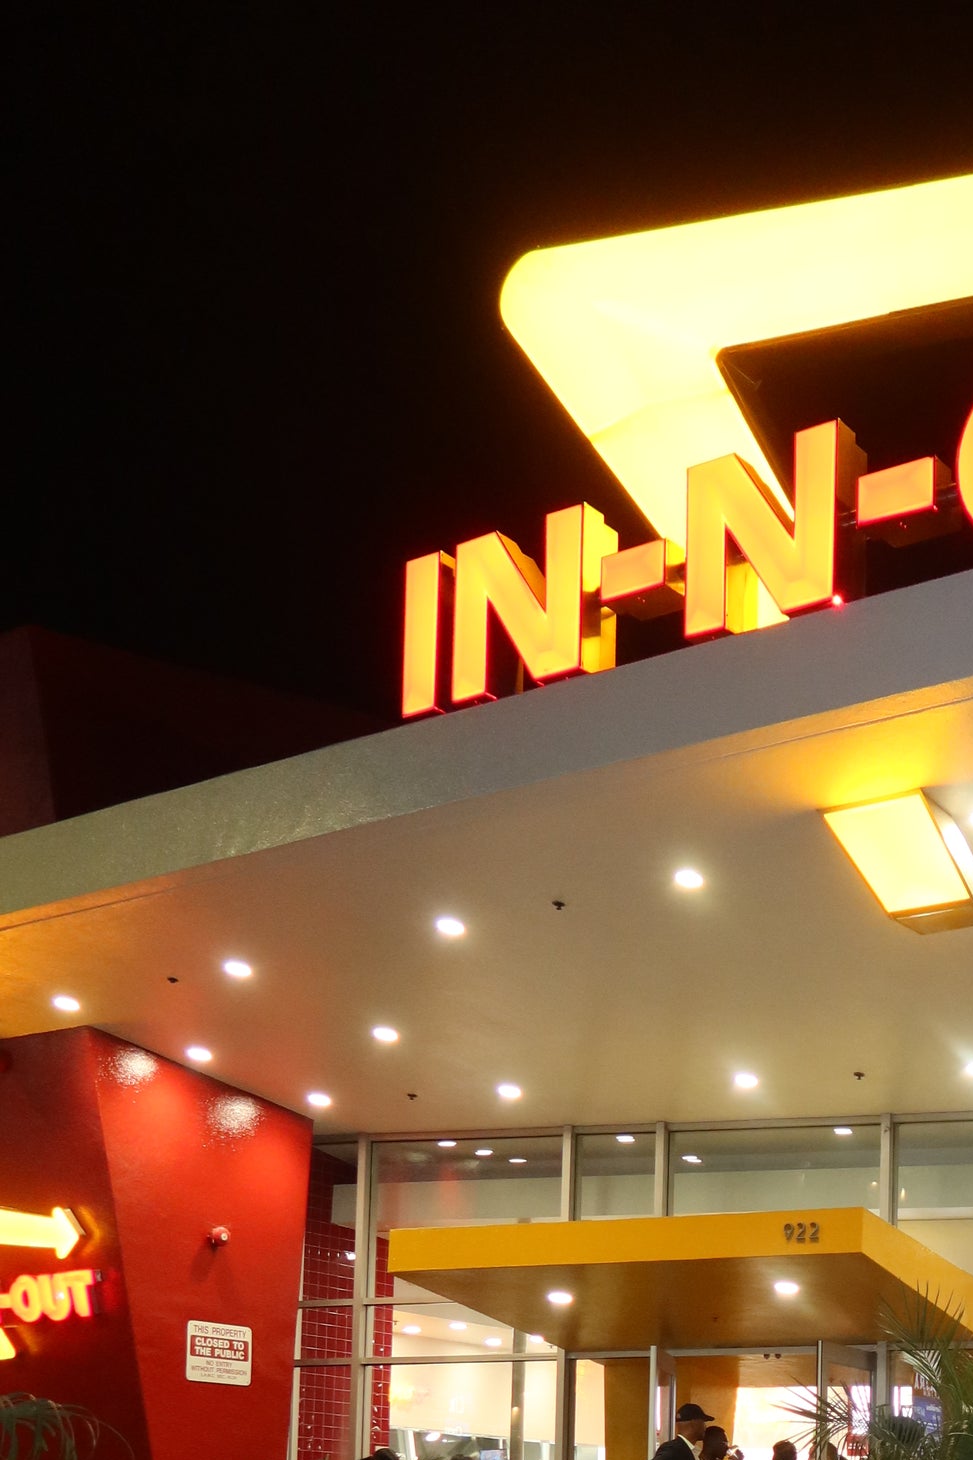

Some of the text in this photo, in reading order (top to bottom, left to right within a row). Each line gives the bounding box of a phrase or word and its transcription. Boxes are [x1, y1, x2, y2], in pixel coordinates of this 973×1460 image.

[783, 1222, 820, 1243] 922
[194, 1325, 246, 1338] THIS PROPERTY
[195, 1337, 245, 1351] CLOSED TO
[194, 1346, 245, 1360] THE PUBLIC
[191, 1365, 247, 1376] WITHOUT PERMISSION
[216, 1361, 233, 1369] ENTRY
